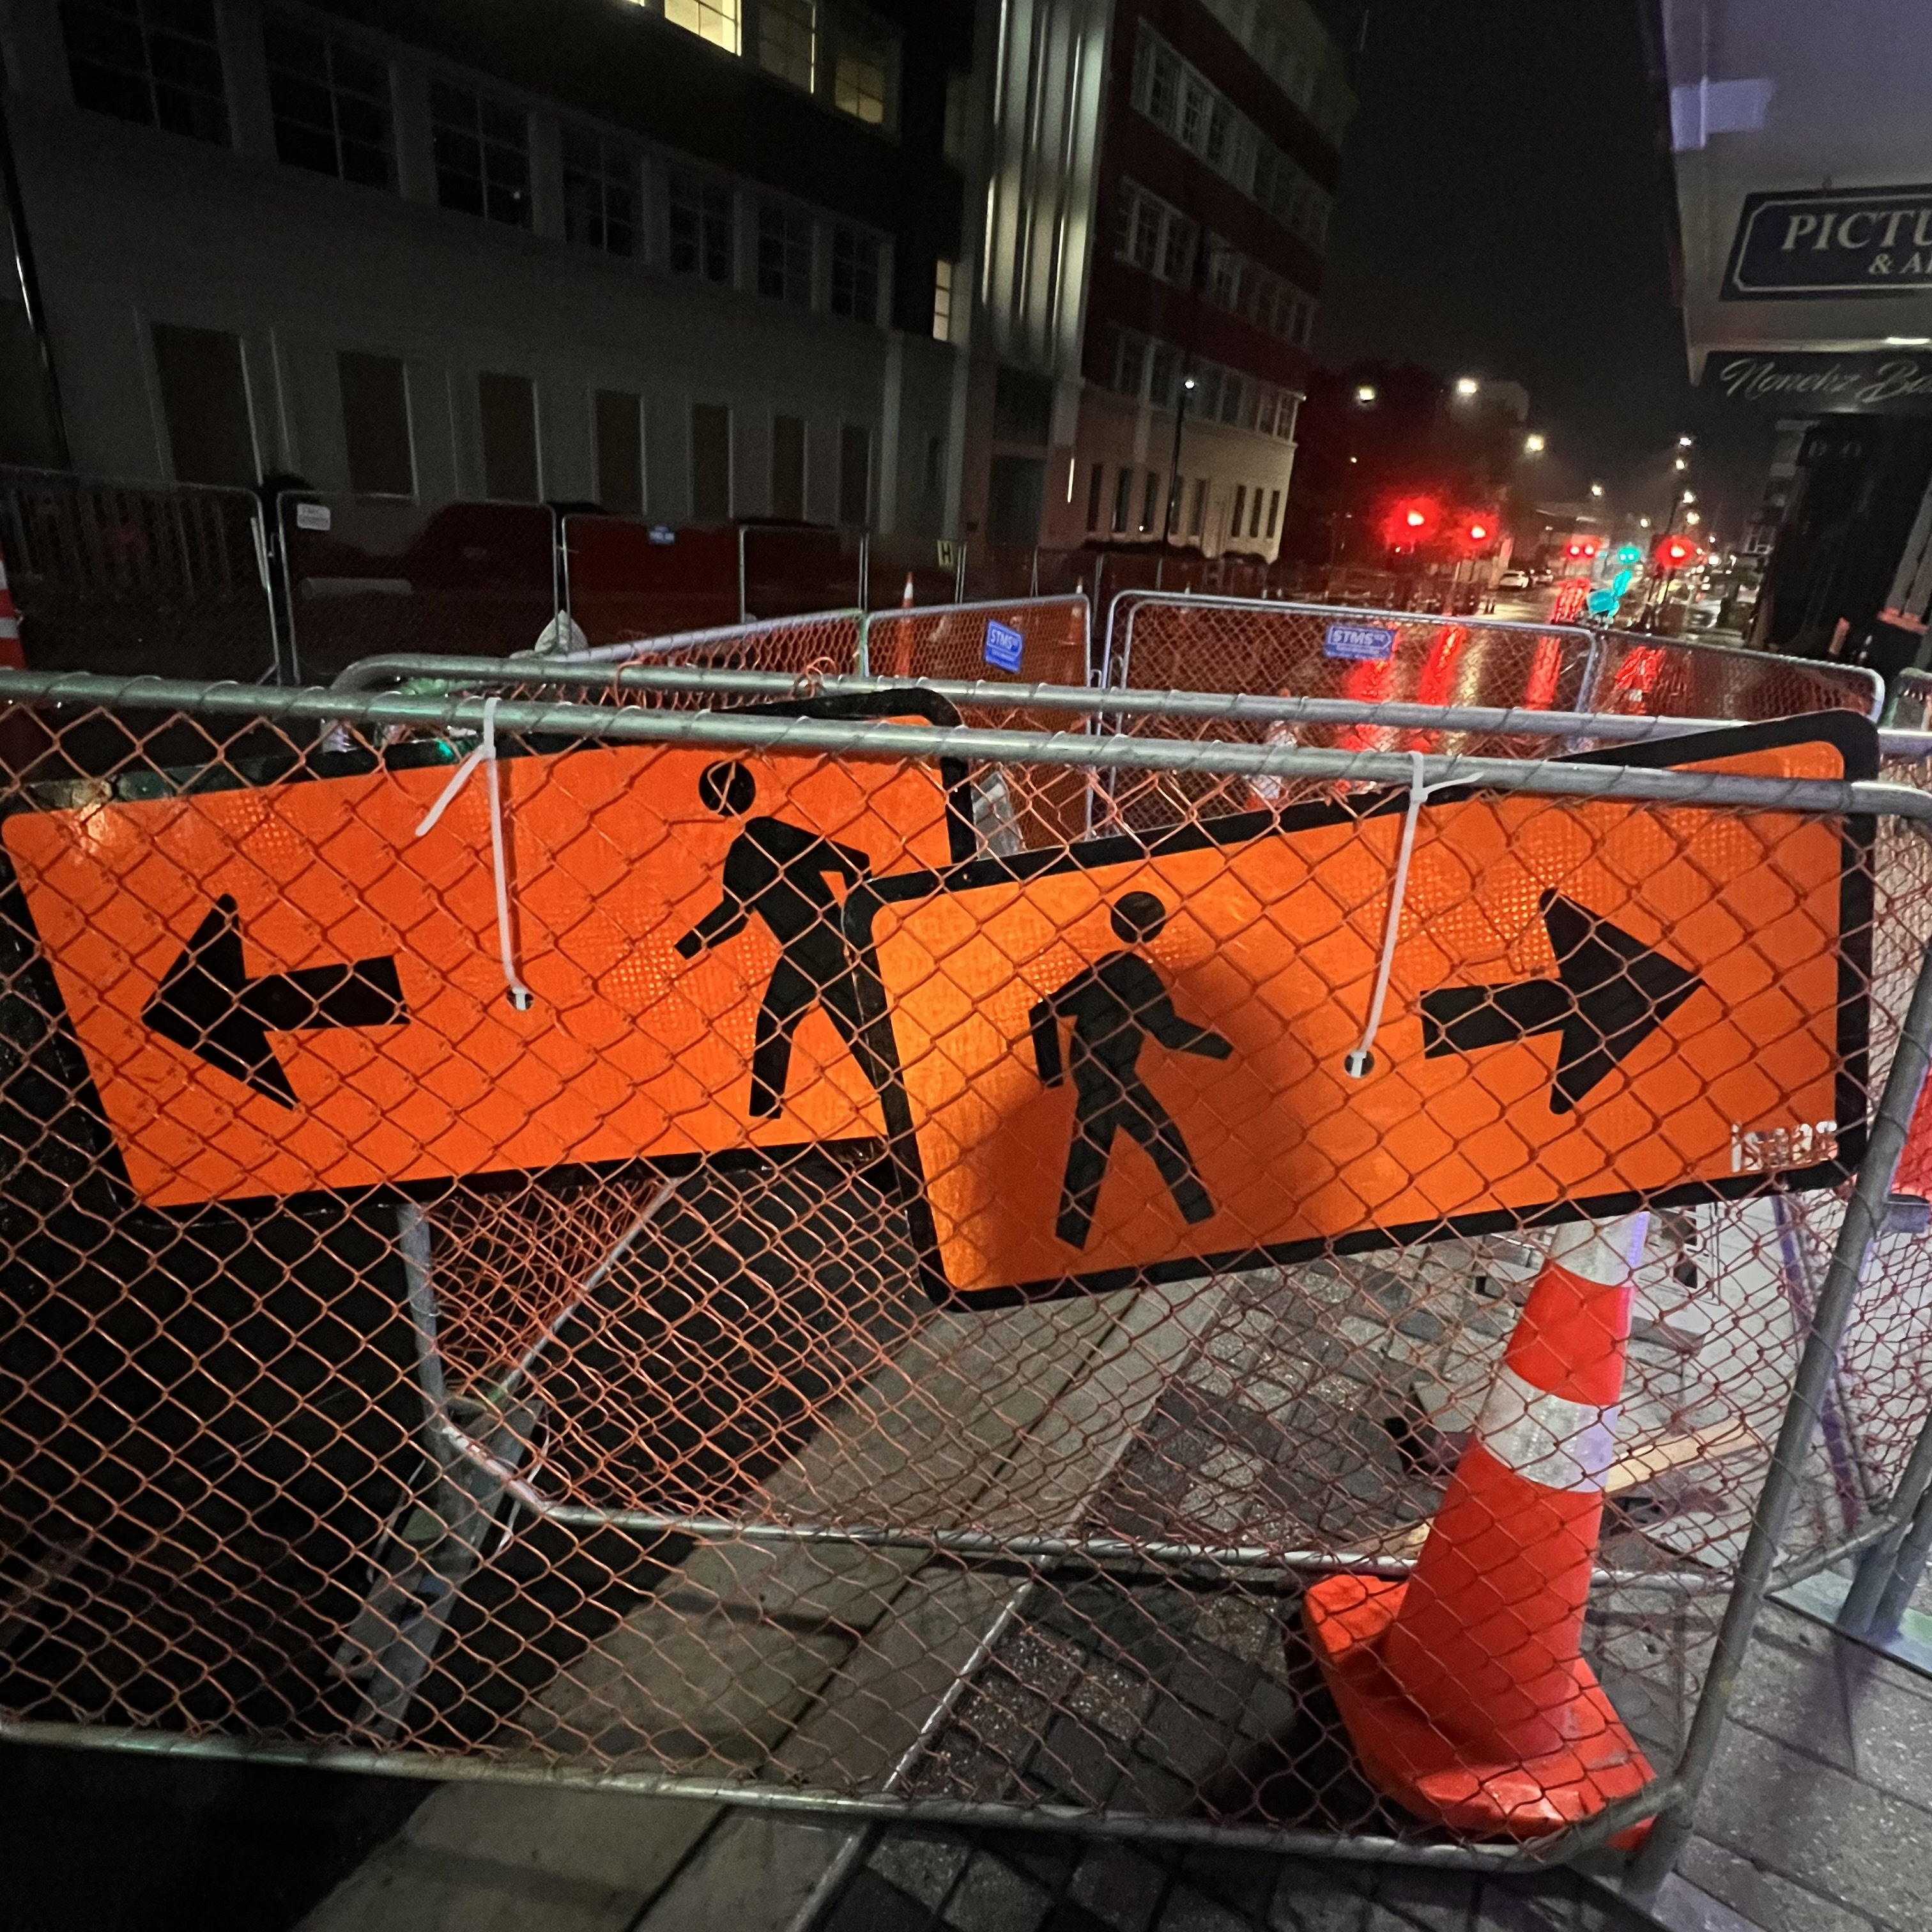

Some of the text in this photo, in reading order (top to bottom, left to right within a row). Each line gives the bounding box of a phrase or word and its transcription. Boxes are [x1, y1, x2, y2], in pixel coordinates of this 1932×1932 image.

[1867, 253, 1894, 274] &
[941, 541, 952, 564] H
[991, 629, 1013, 650] STMS
[1333, 630, 1374, 645] STMS
